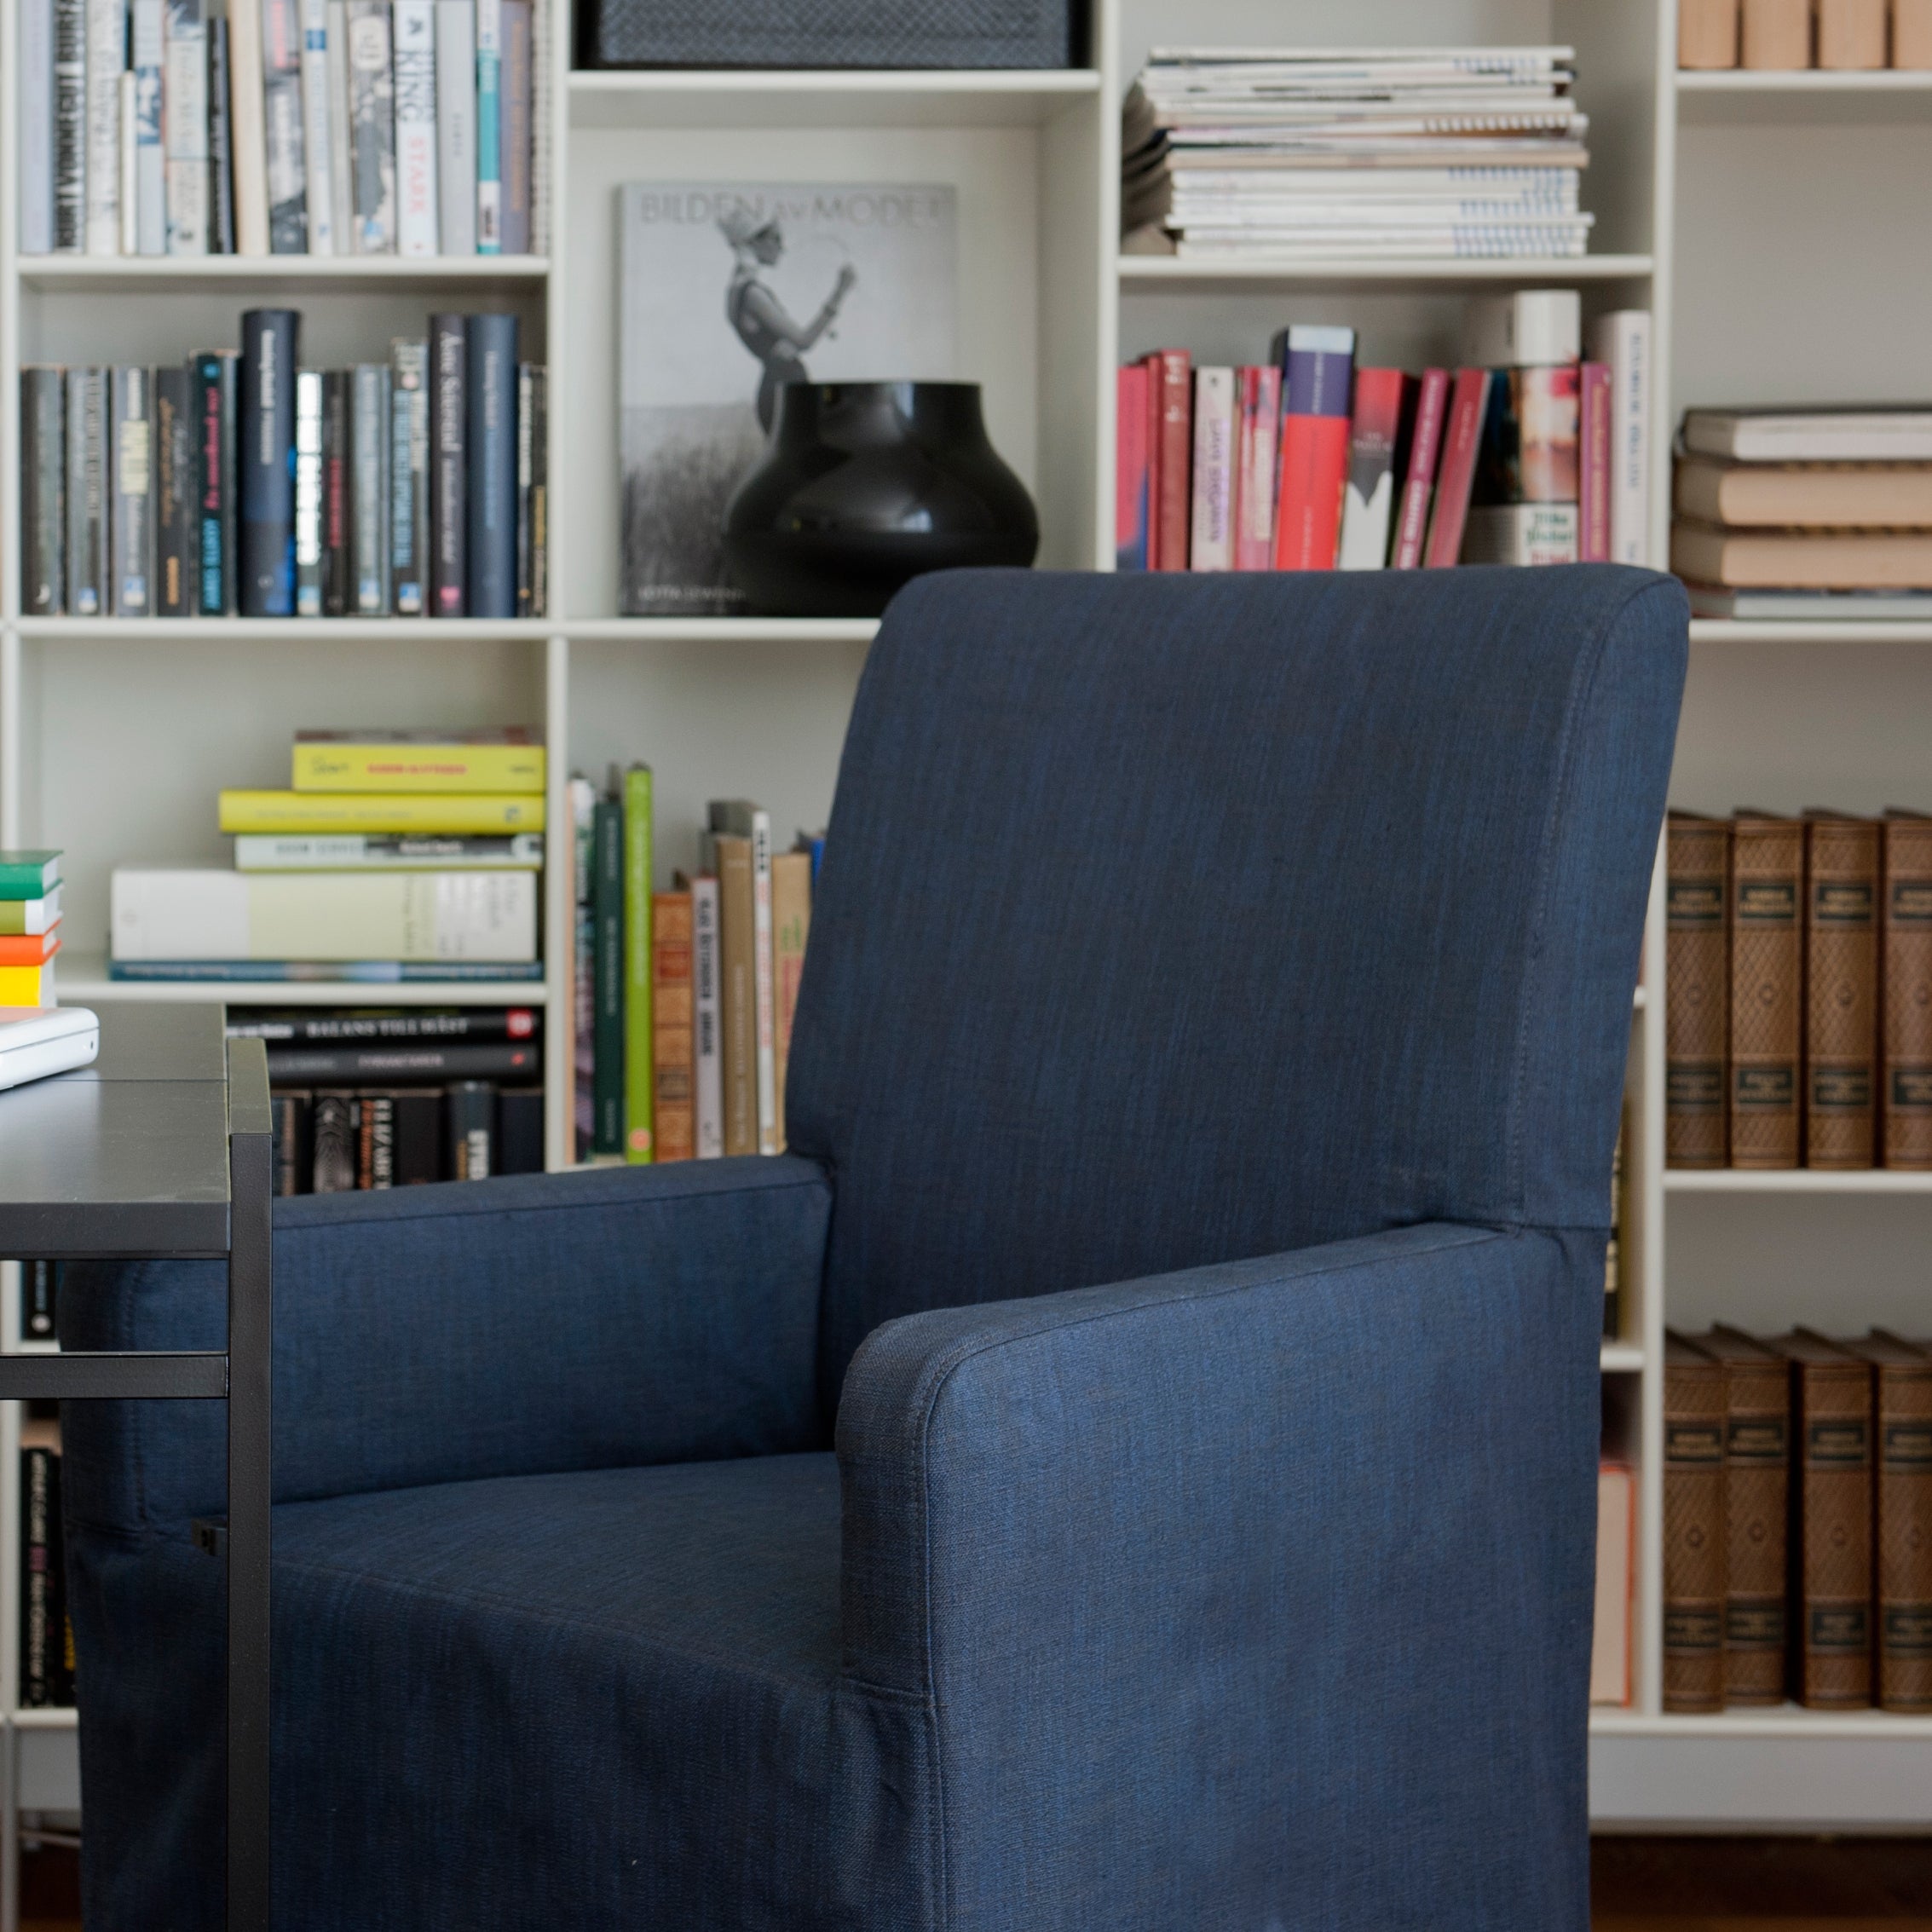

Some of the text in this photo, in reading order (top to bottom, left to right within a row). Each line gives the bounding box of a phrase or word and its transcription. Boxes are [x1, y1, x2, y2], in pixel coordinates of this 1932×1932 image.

[395, 49, 424, 123] KING
[407, 136, 426, 215] STARK
[639, 191, 763, 225] BILDEN
[305, 1018, 376, 1038] BALANS
[377, 1018, 418, 1036] TILL
